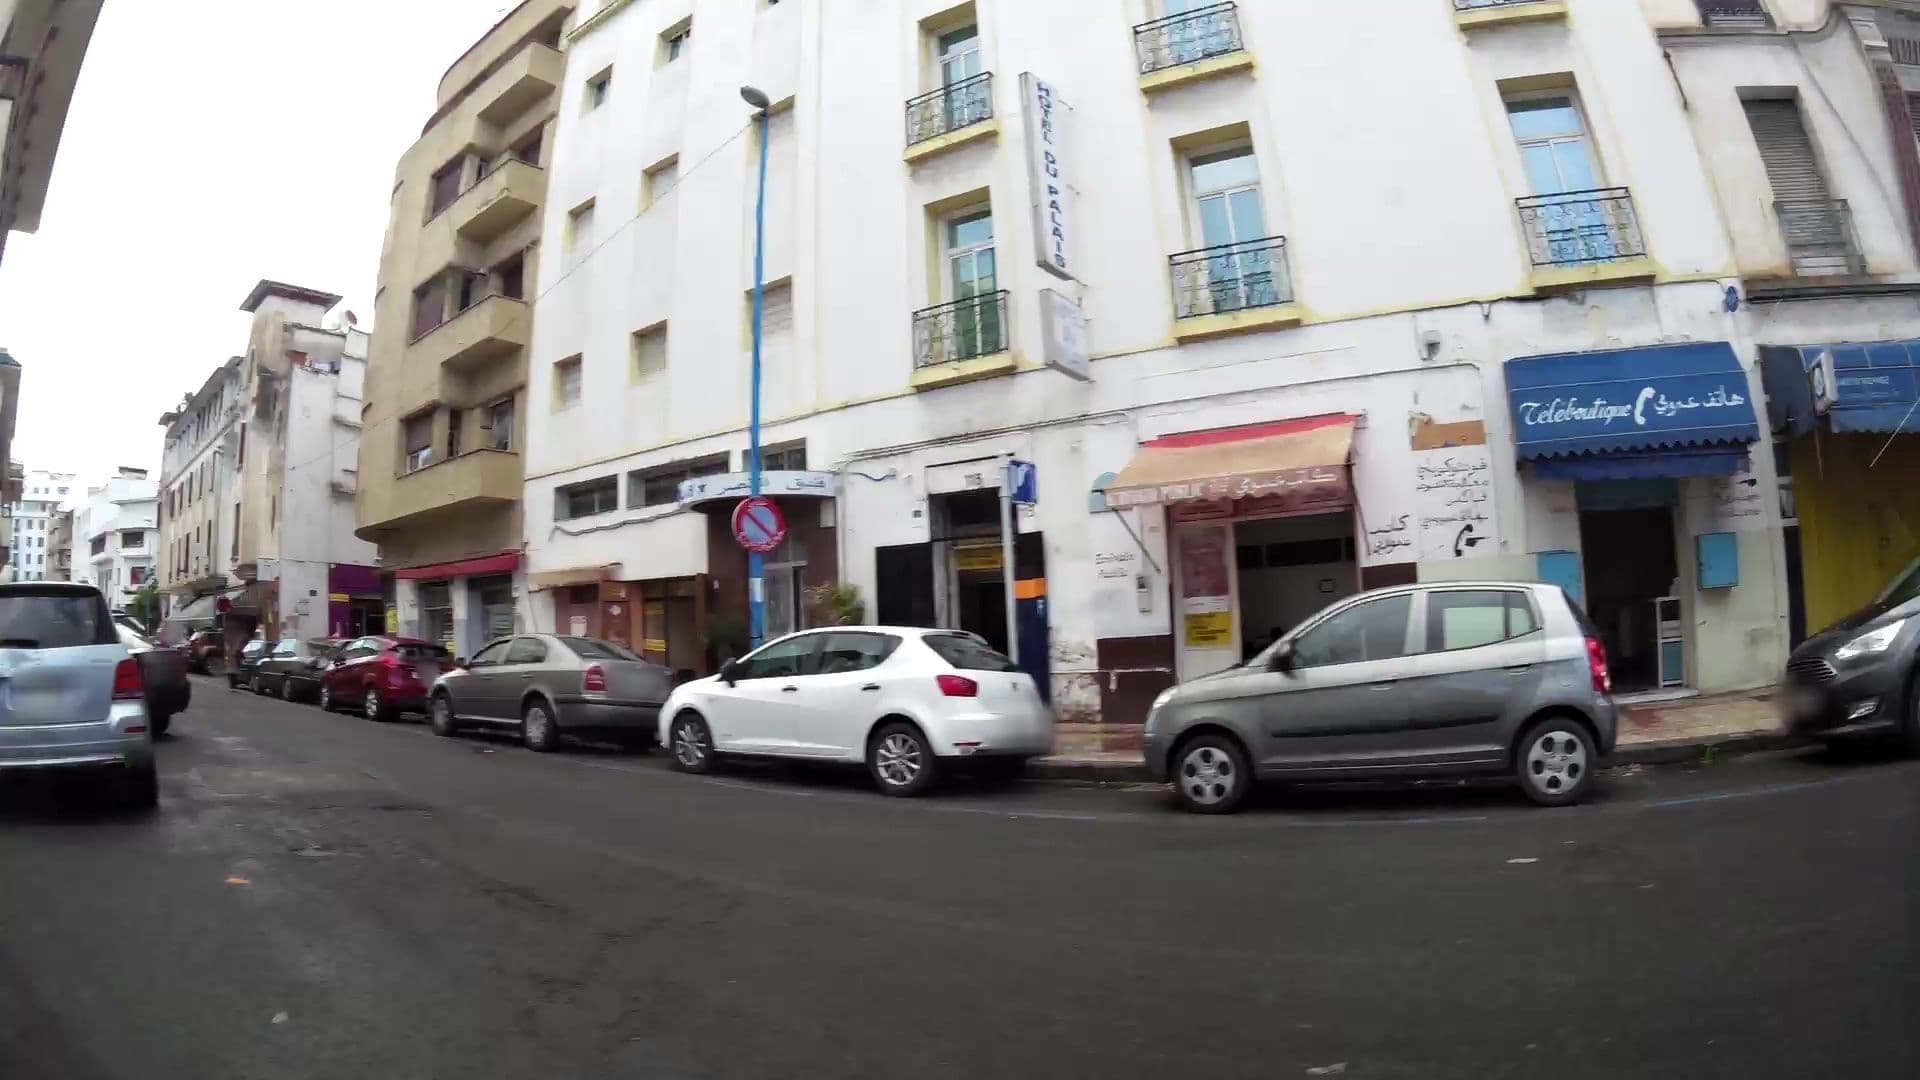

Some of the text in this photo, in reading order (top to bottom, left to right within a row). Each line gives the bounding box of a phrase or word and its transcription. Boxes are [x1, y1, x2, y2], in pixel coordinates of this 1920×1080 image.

[1043, 151, 1059, 179] DU
[1046, 184, 1067, 269] PALAIS
[1653, 384, 1745, 417] هاتف عمومي
